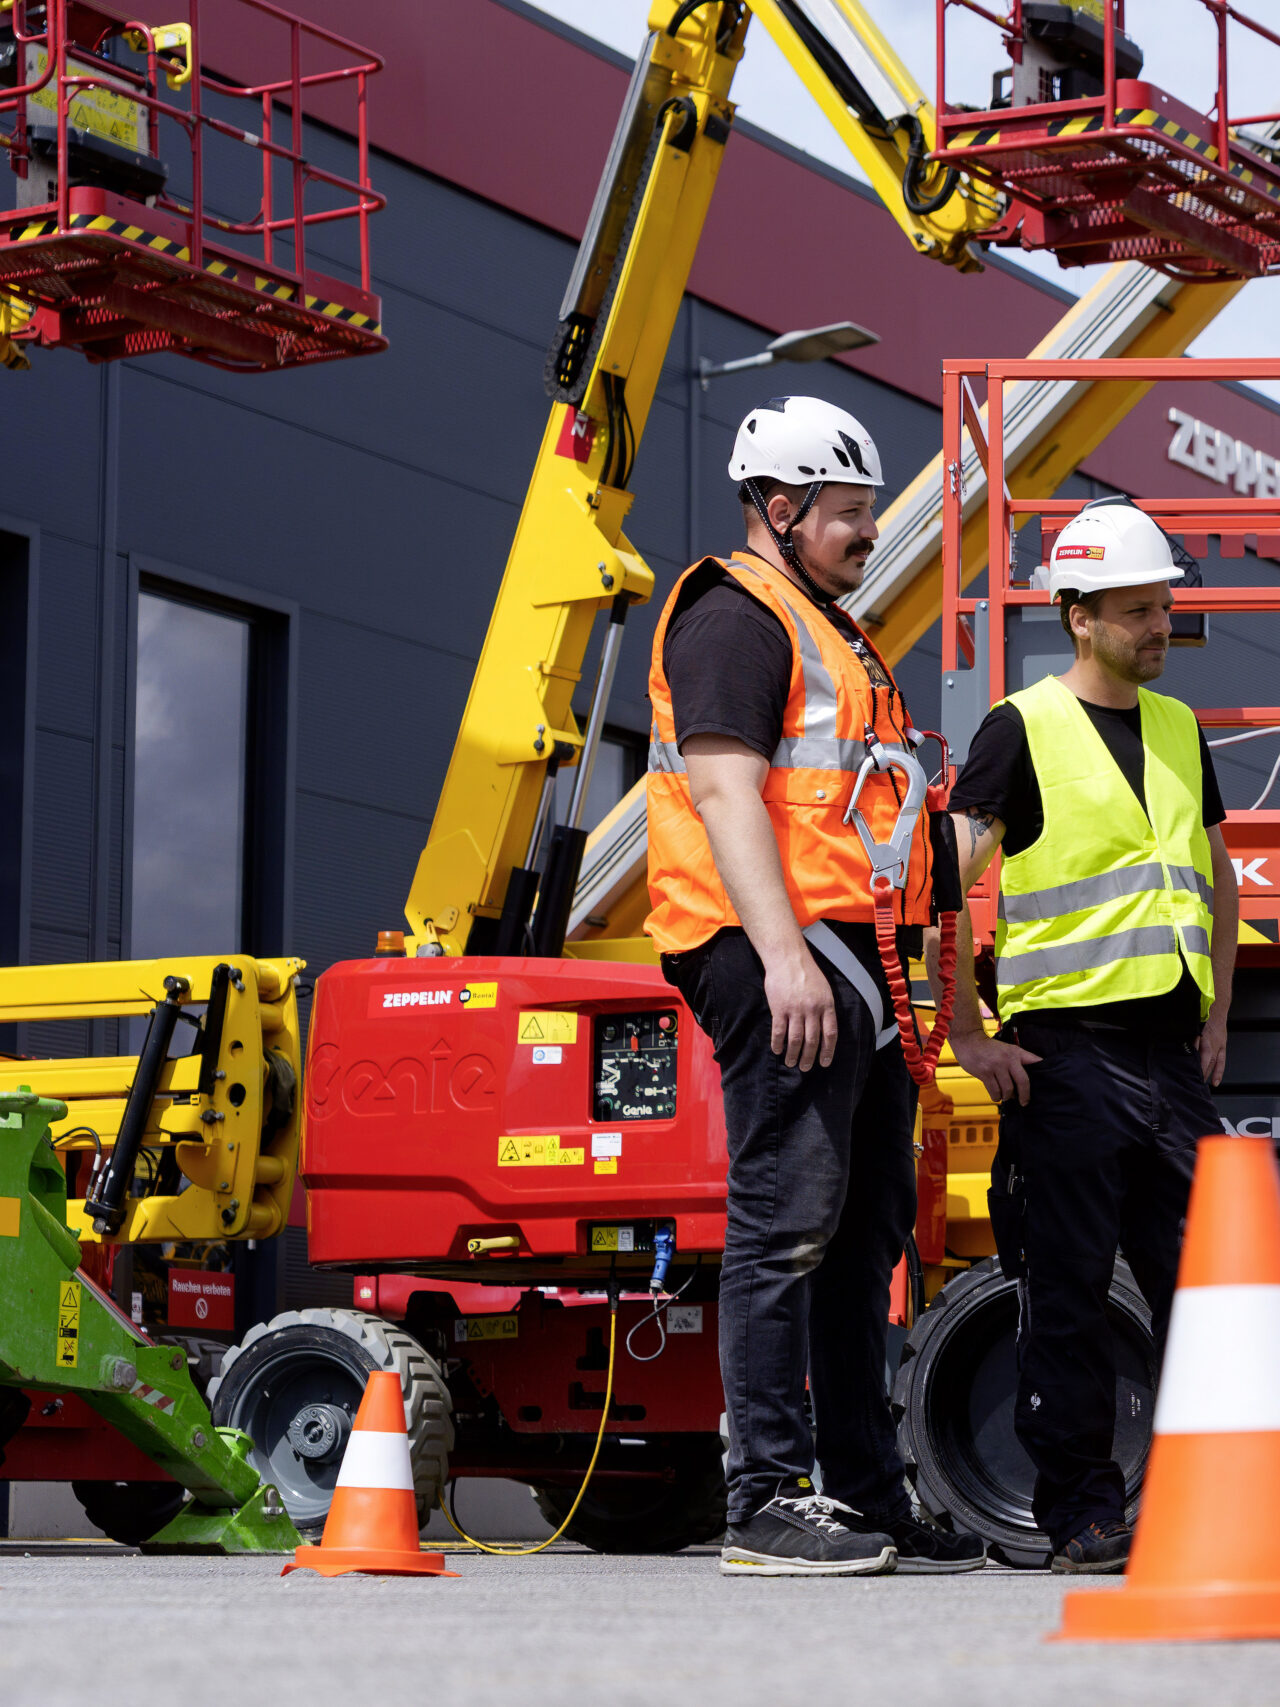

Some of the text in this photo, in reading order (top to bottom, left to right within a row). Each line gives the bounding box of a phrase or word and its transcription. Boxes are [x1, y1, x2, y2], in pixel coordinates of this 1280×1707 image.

[383, 990, 453, 1008] ZEPPELIN
[307, 1037, 496, 1121] Genie
[622, 1104, 653, 1116] Genie
[172, 1279, 231, 1297] Rauchen verboten
